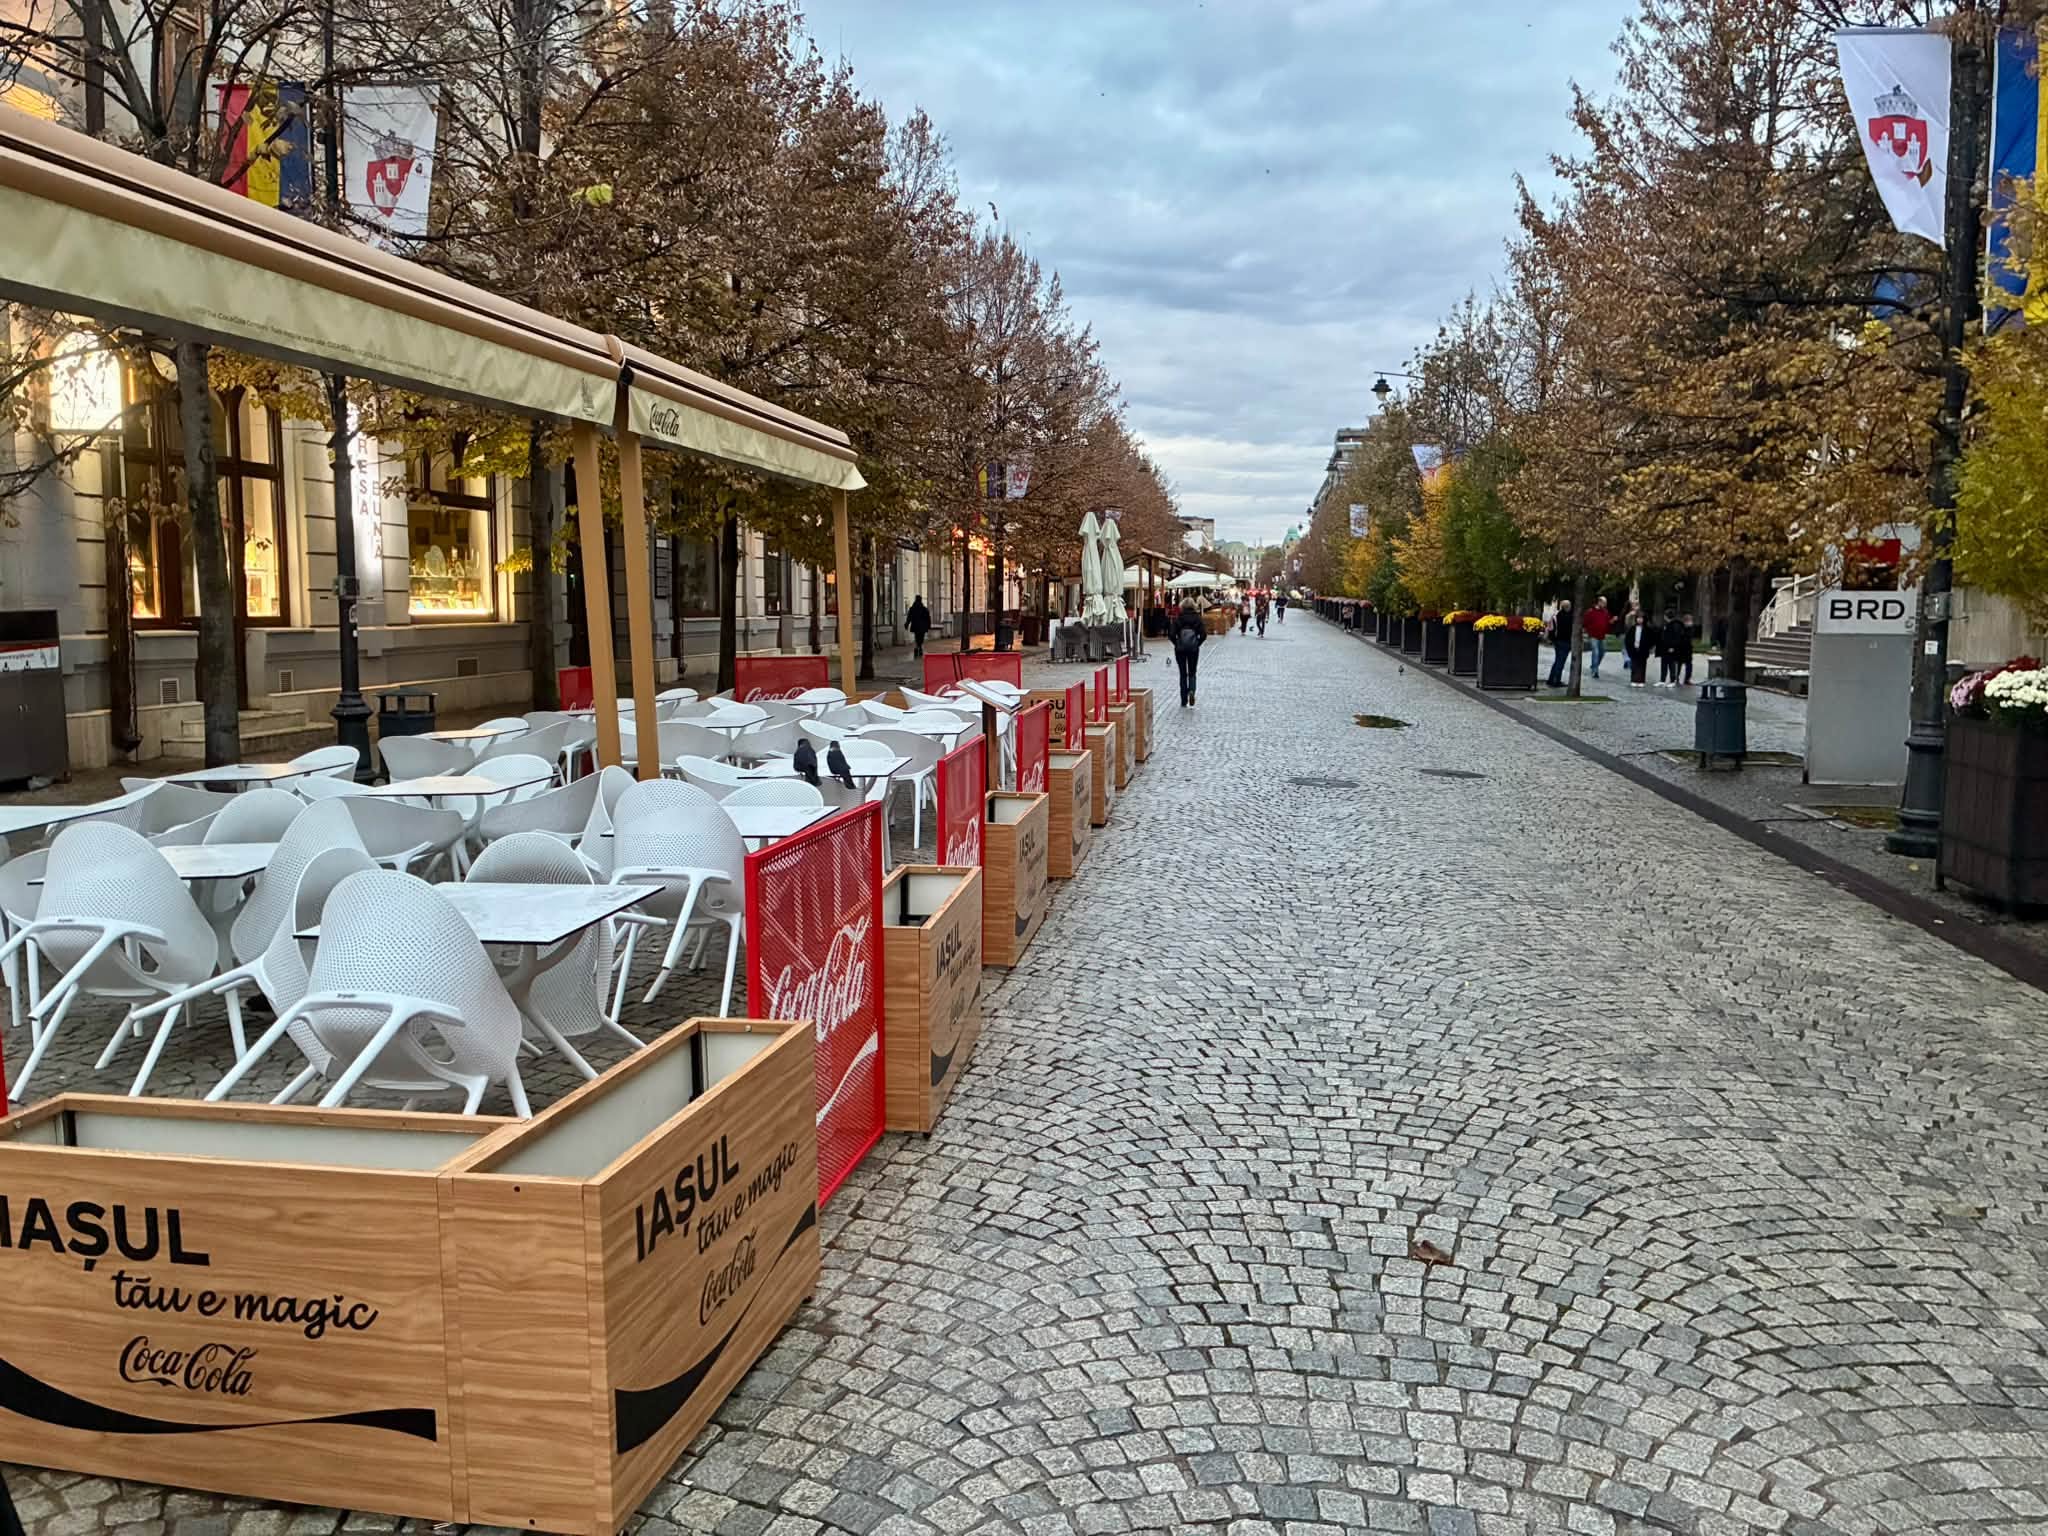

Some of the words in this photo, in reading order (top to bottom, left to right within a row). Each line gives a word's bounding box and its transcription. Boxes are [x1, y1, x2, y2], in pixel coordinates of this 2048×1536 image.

[649, 402, 680, 437] Coca-Cola
[1829, 599, 1905, 620] BRD
[0, 1194, 210, 1272] IAȘUL
[634, 1133, 740, 1264] IAȘUL
[696, 1207, 733, 1255] tău
[734, 1192, 747, 1221] e
[748, 1141, 798, 1209] magic
[111, 1269, 192, 1313] tău
[197, 1289, 227, 1317] e
[234, 1292, 379, 1340] magic
[700, 1226, 758, 1326] Coca-Cola
[119, 1335, 258, 1396] Coca-Cola
